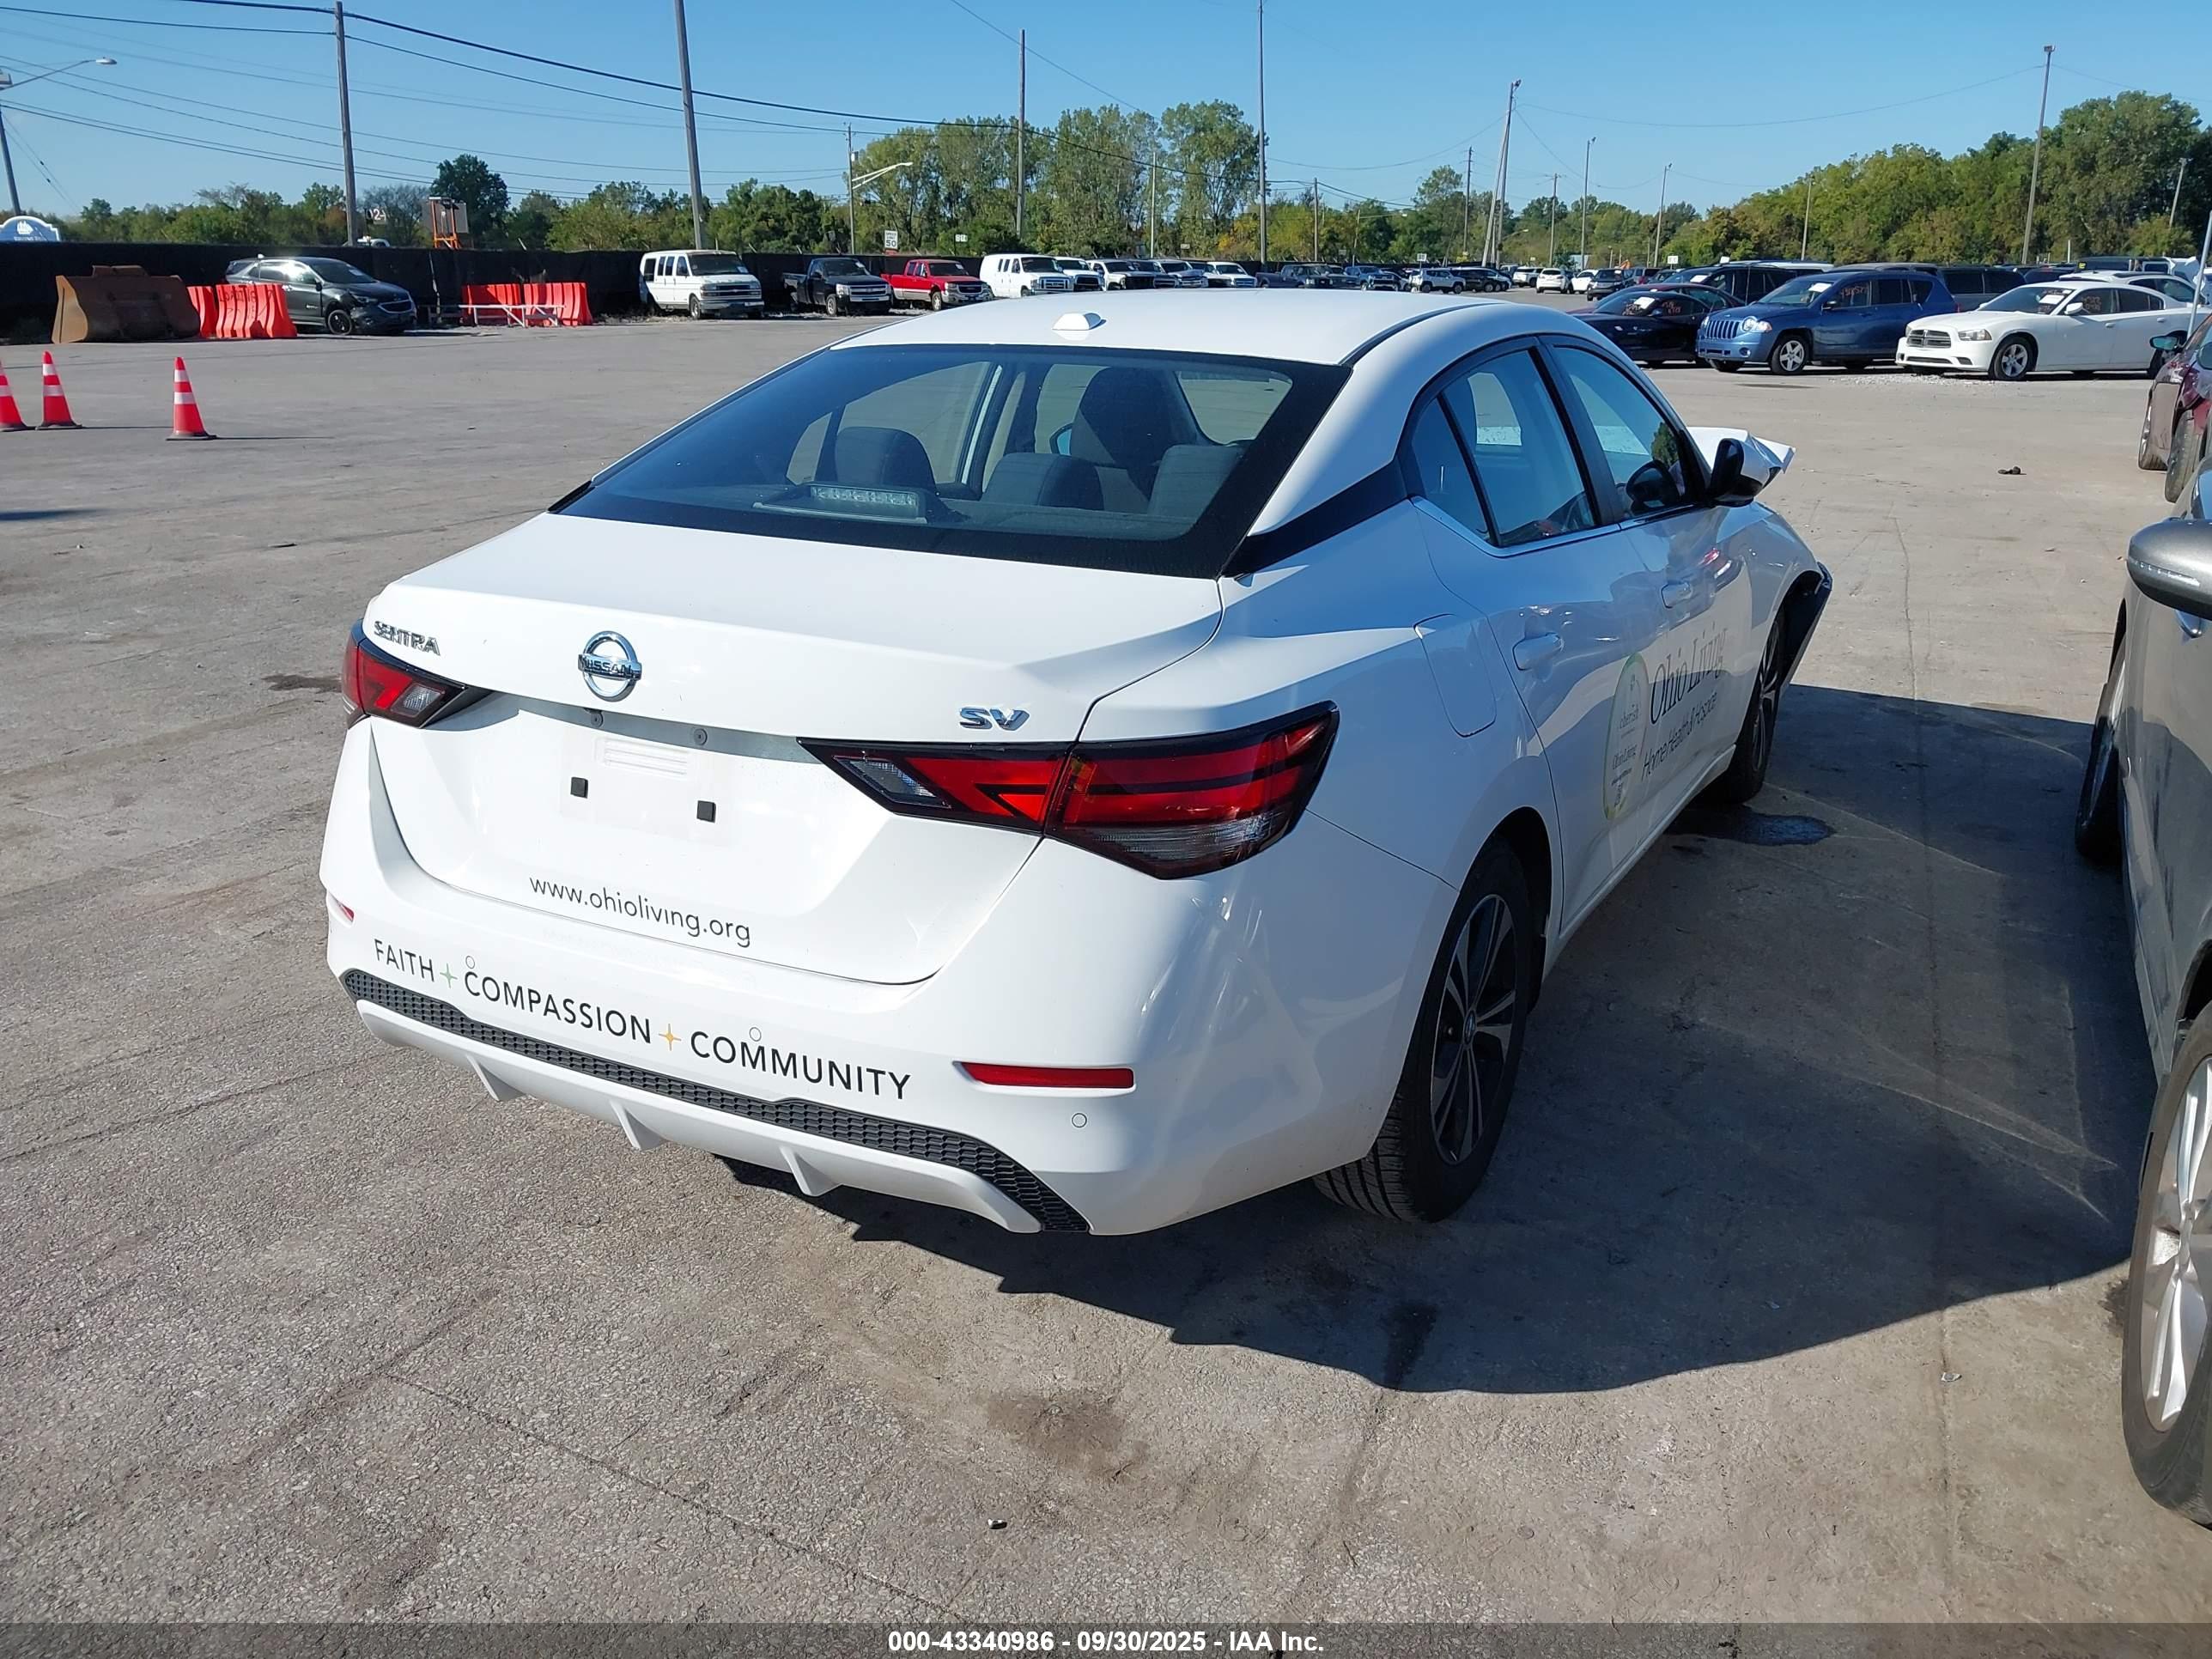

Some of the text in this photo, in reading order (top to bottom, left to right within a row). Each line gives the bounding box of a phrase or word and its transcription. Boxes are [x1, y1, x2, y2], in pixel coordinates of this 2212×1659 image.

[374, 620, 441, 656] SENTRA
[583, 656, 633, 677] NISSAN
[1650, 621, 1728, 725] Ohio Living
[959, 706, 1030, 732] SV
[529, 878, 750, 948] www.ohioliving.org
[374, 939, 911, 1100] FAITH COMPASSION COMMUNITY
